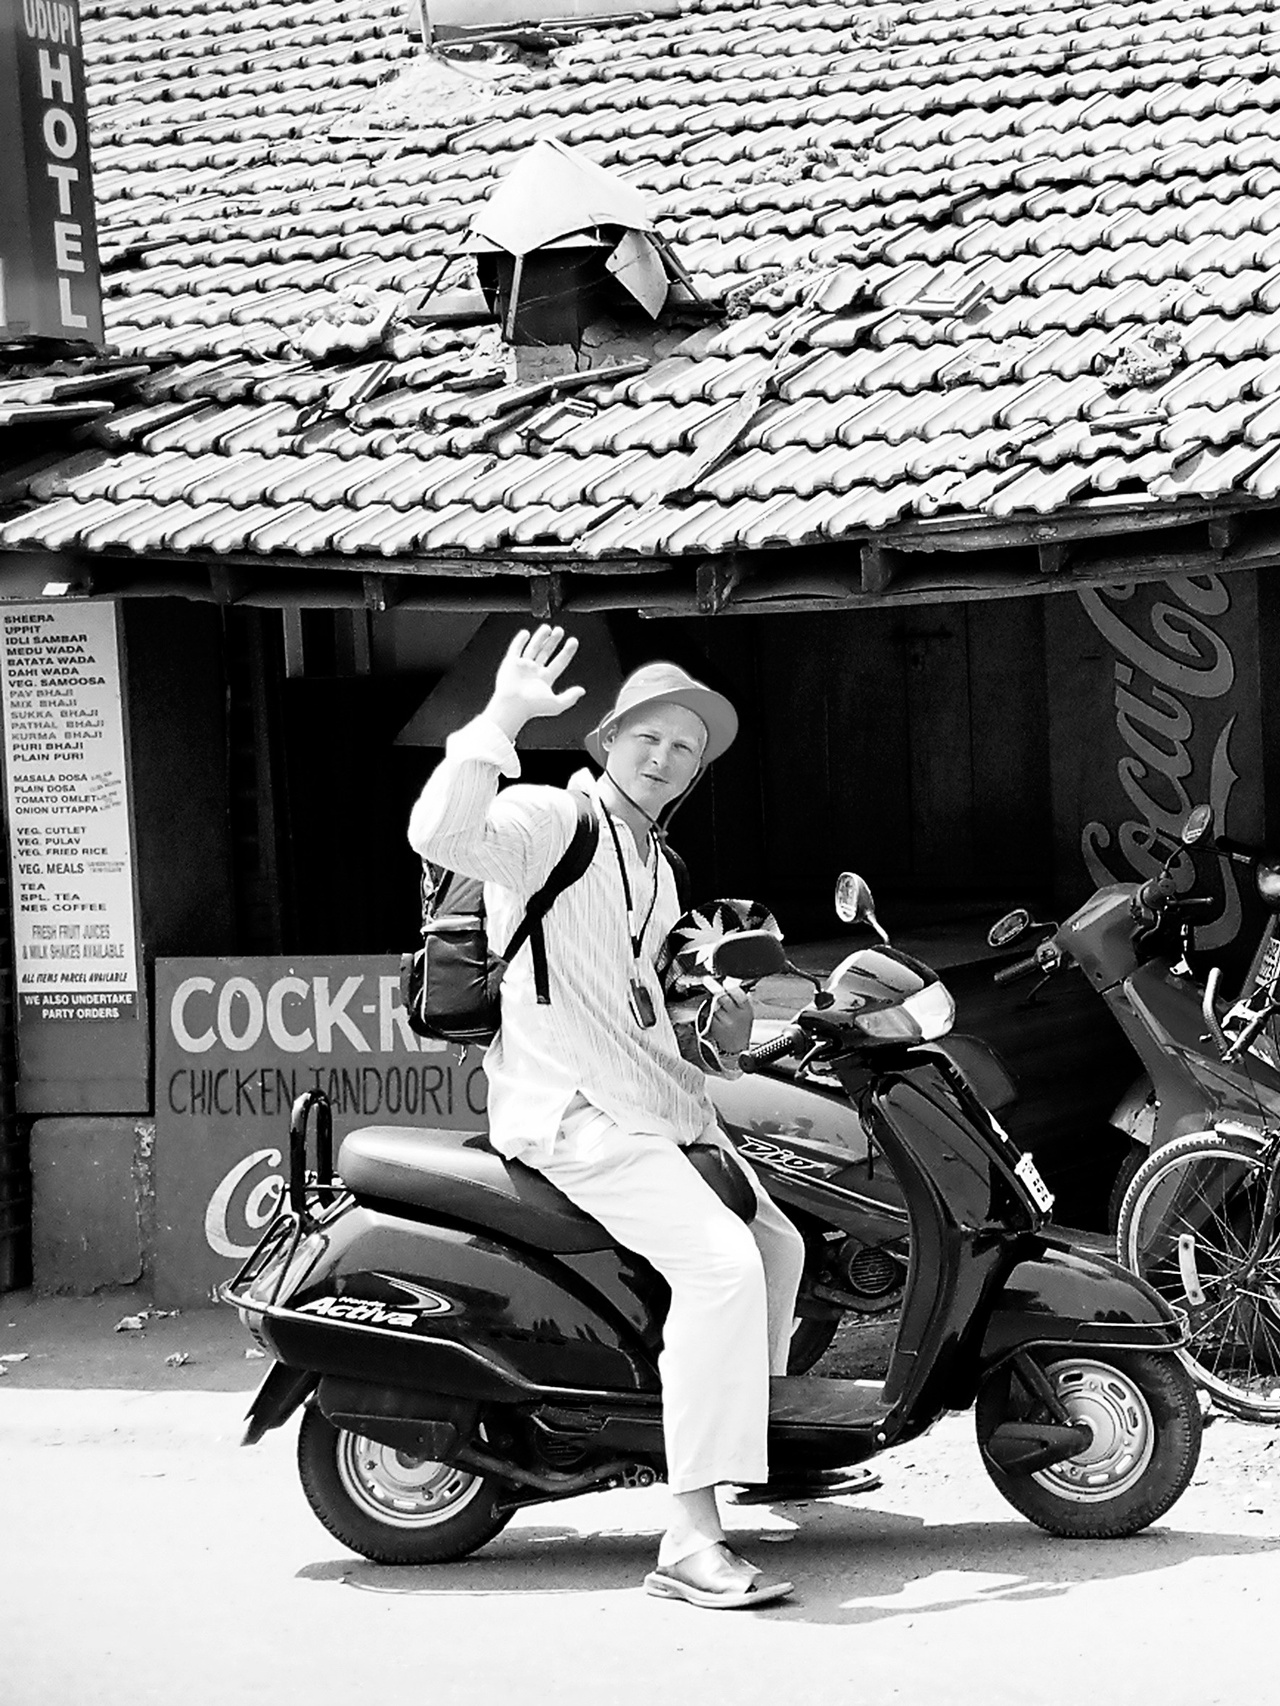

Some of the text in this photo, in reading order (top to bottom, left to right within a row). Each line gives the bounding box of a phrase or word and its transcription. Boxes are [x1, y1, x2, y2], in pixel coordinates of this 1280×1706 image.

[23, 0, 77, 47] UDUPI
[38, 48, 88, 329] HOTEL
[4, 614, 55, 624] SHEERA
[5, 625, 41, 635] UPPIT
[6, 634, 87, 645] IDLI SAMBAR
[7, 645, 84, 656] MEDU WADA
[7, 655, 96, 666] BATATA WADA
[8, 667, 79, 677] DAHI WADA
[8, 677, 105, 688] VEG. SAMOOSA
[36, 688, 74, 698] BHAJI
[10, 699, 77, 709] MIX BHAJI
[60, 709, 98, 718] BHAJI
[66, 719, 104, 728] BHAJI
[64, 731, 103, 740] BHAJI
[12, 741, 84, 751] PURI BHAJI
[13, 752, 84, 762] PLAIN PURI
[13, 774, 55, 783] MASALA
[58, 773, 88, 782] DOSA
[14, 784, 76, 793] PLAIN DOSA
[15, 795, 58, 804] TOMATO
[61, 795, 96, 803] OMLET
[15, 806, 49, 815] ONION
[51, 805, 98, 814] UTTAPPA
[45, 826, 87, 835] CUTLET
[45, 837, 81, 846] PULAV
[46, 848, 78, 856] FRIED
[82, 847, 108, 856] RICE
[18, 863, 44, 875] VEG.
[46, 862, 85, 874] MEALS
[20, 883, 46, 891] TEA
[20, 892, 80, 901] SPL. TEA
[20, 903, 107, 912] NES COFFEE
[24, 993, 133, 1005] WE ALSO UNDERTAKE
[42, 1007, 120, 1019] PARTY ORDERS
[169, 1068, 300, 1116] CHICKEN
[312, 1066, 452, 1115] TANDOORI
[295, 1296, 418, 1328] Activa
